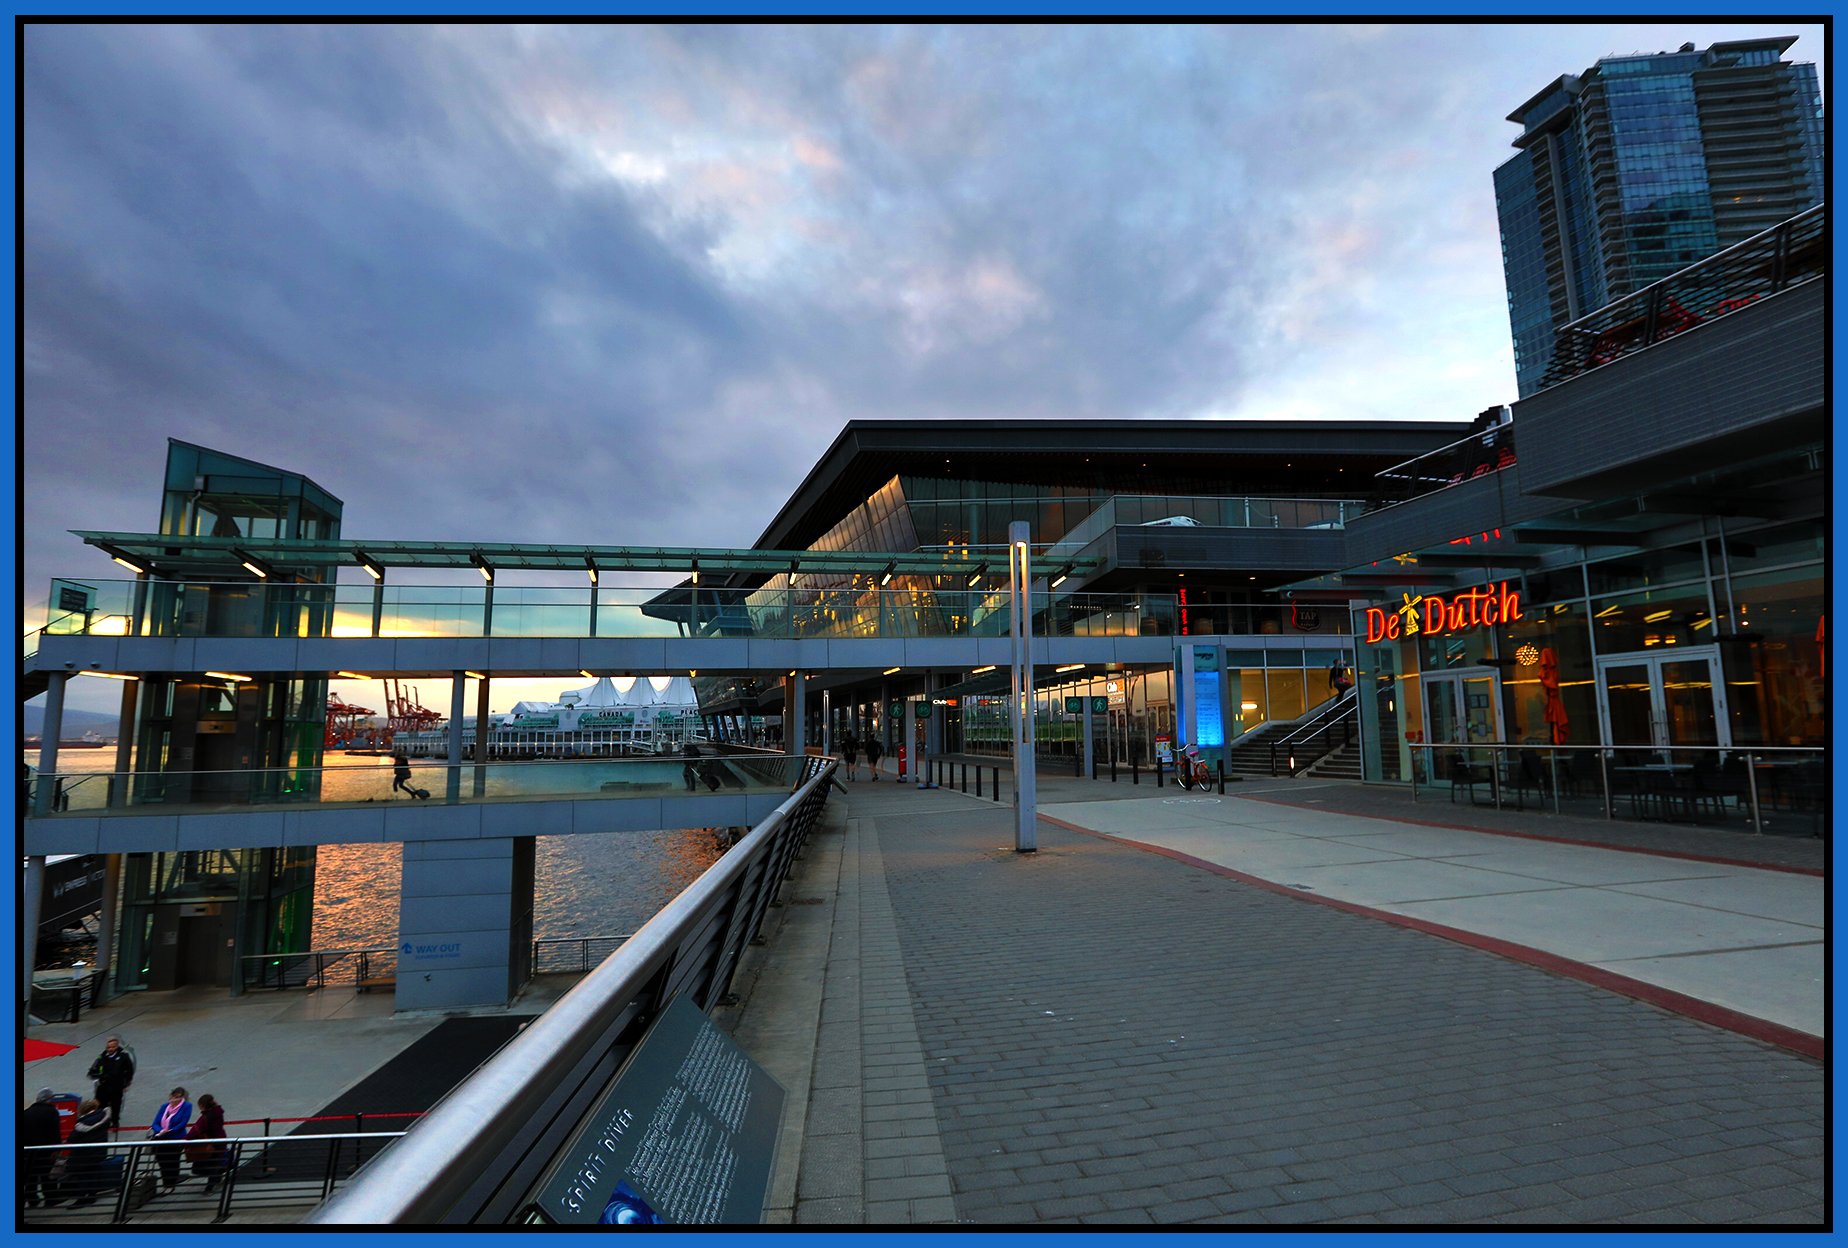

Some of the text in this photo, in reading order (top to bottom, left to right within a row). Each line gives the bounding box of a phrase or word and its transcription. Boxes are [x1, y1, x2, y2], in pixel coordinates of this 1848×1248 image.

[1300, 612, 1316, 620] TAP
[1366, 581, 1523, 644] De Dutch
[416, 943, 461, 954] WAY OUT
[569, 1108, 635, 1214] SPIRIT DIVER
